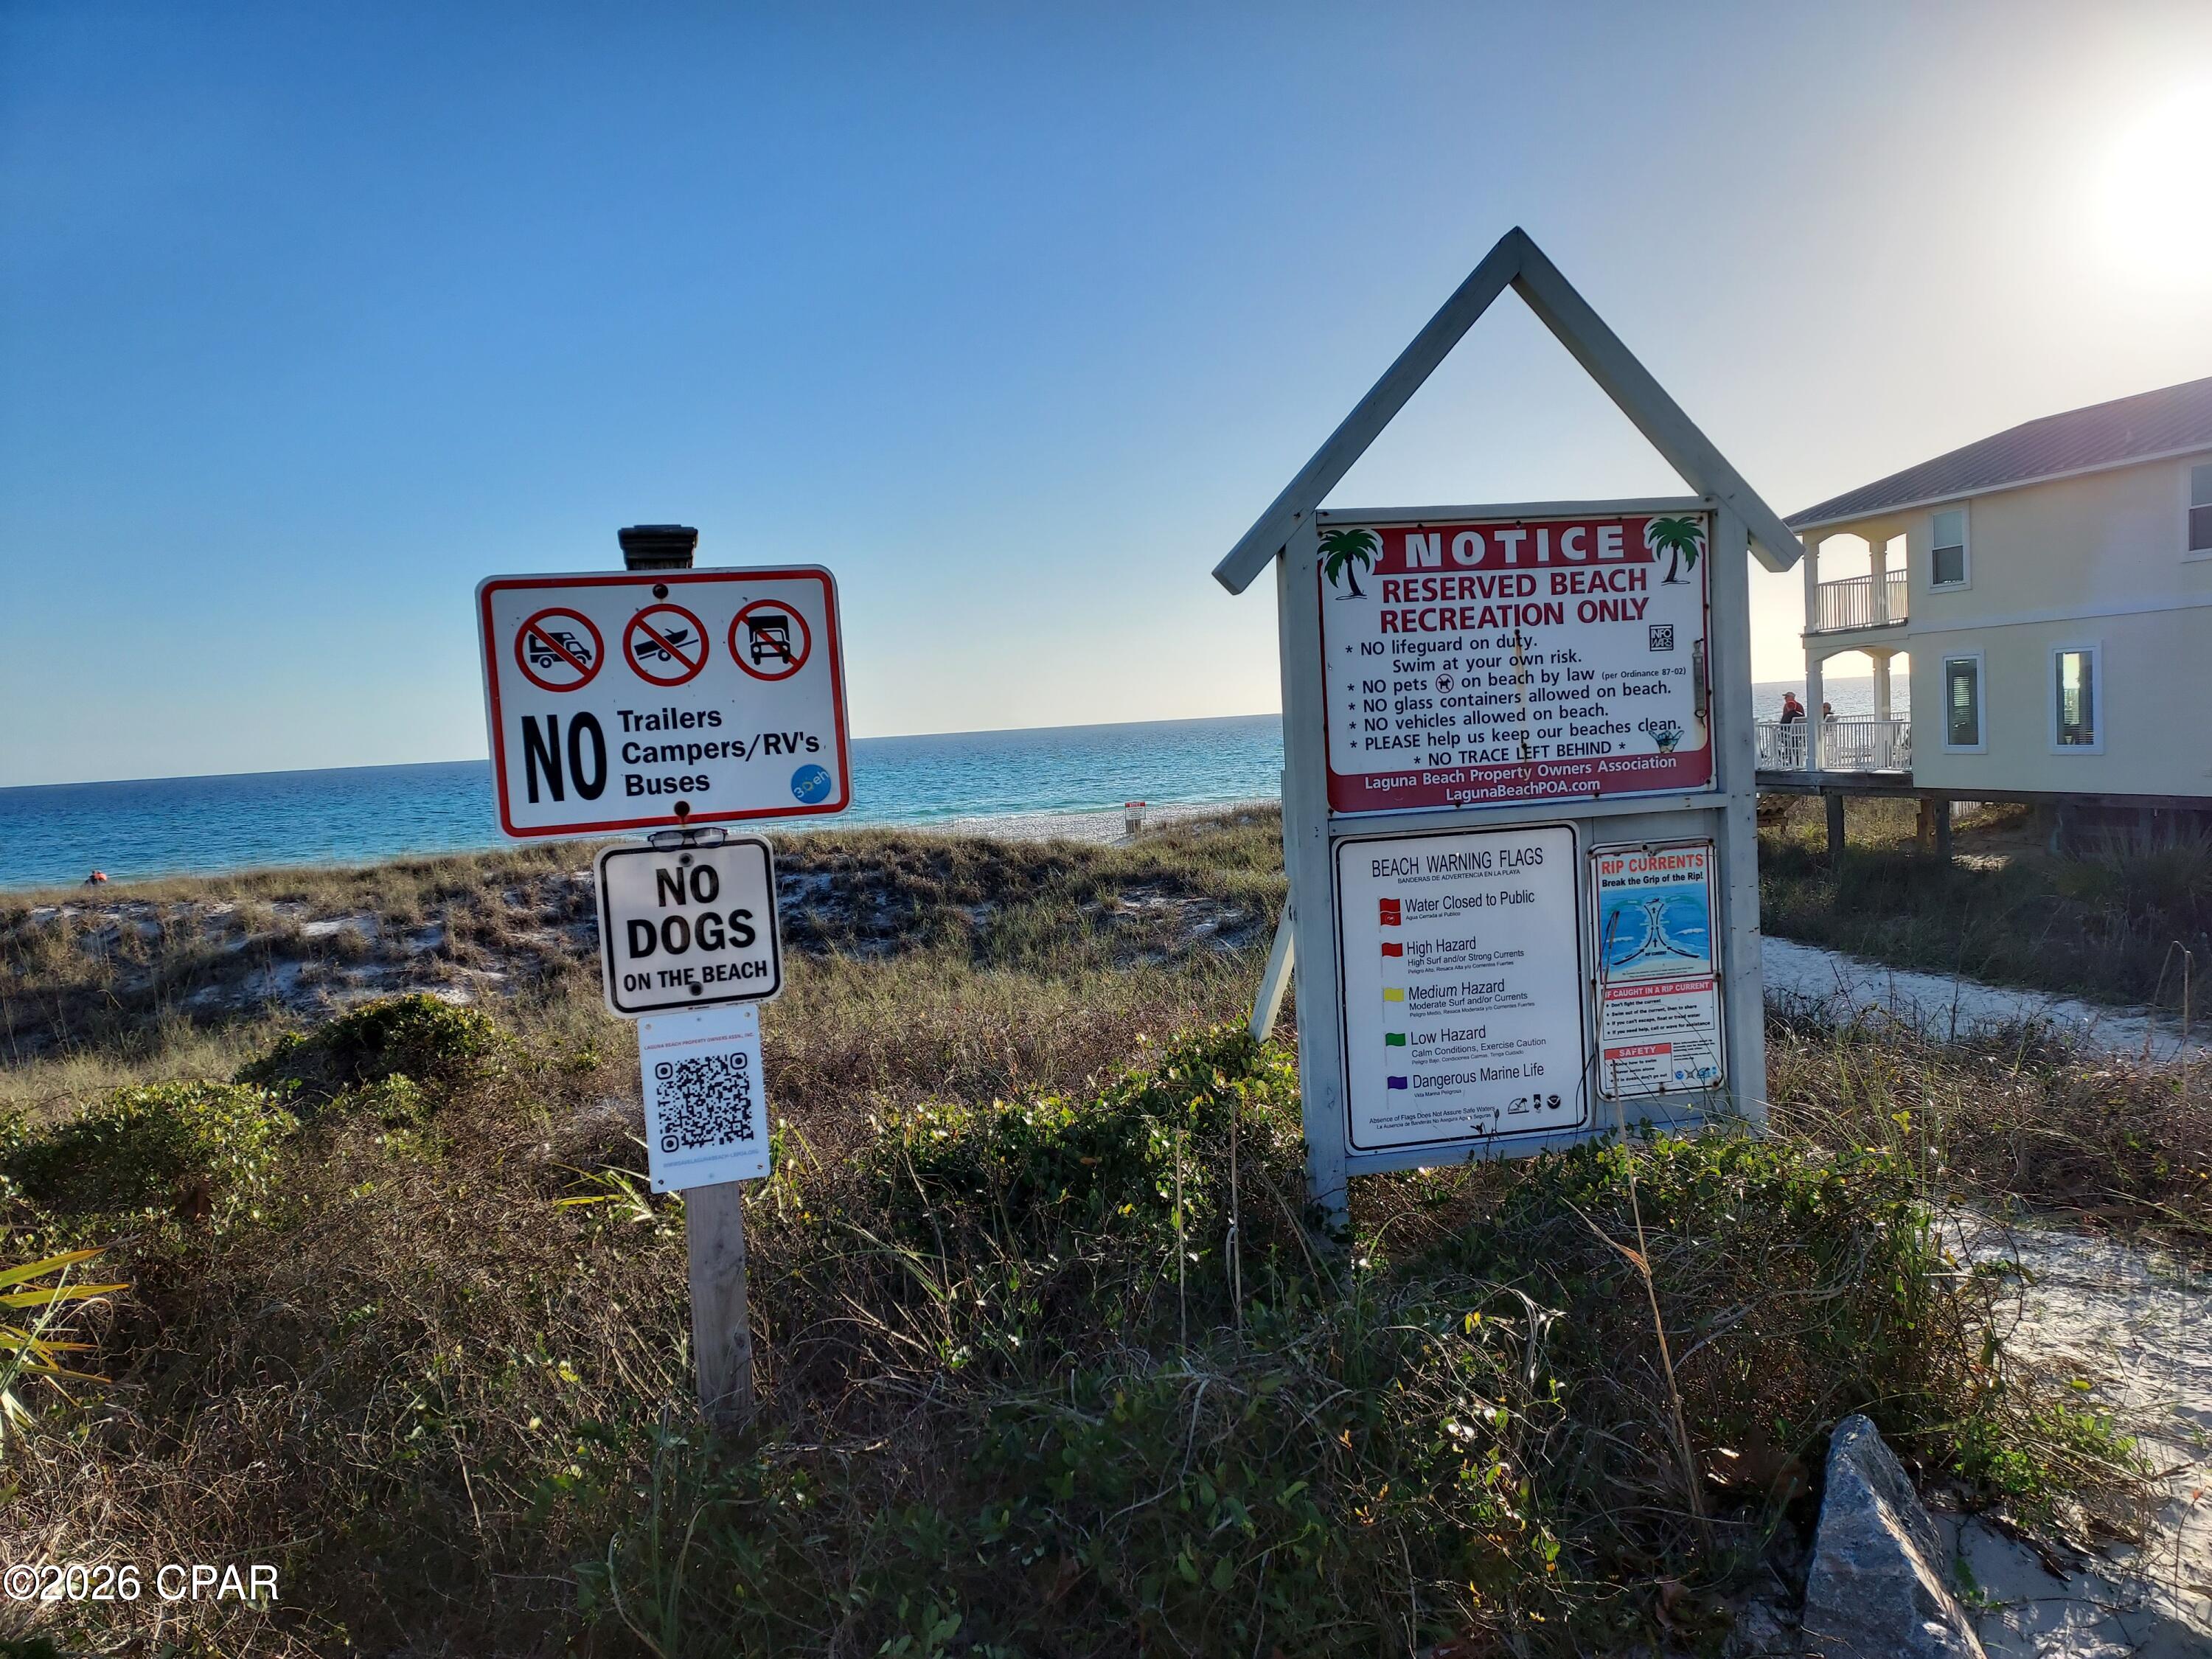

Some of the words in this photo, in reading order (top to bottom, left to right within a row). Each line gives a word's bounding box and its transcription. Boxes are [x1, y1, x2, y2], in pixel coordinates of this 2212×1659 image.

[1405, 525, 1624, 568] NOTICE
[1382, 574, 1537, 603] RESERVED
[1551, 568, 1646, 596] BEACH
[1380, 602, 1564, 633] RECREATION
[1577, 597, 1649, 623] ONLY
[1361, 641, 1385, 655] NO
[1392, 636, 1462, 657] lifeguard
[1470, 639, 1489, 650] on
[1496, 633, 1537, 653] duty.
[1651, 628, 1672, 638] INFO
[1393, 658, 1435, 673] Swim
[1443, 657, 1458, 670] at
[1466, 657, 1502, 672] your
[1509, 655, 1543, 666] own
[1551, 649, 1582, 664] risk.
[1363, 679, 1386, 694] NO
[1394, 678, 1427, 696] pets
[1461, 677, 1481, 688] on
[1488, 669, 1534, 686] beach
[1541, 669, 1559, 686] by
[1567, 667, 1595, 681] law
[1601, 671, 1618, 681] (per
[1621, 669, 1659, 678] Ordinance
[1662, 667, 1686, 675] 87-02)
[1363, 698, 1387, 713] NO
[1394, 696, 1433, 714] glass
[1440, 691, 1521, 708] containers
[1528, 684, 1590, 703] allowed
[1597, 687, 1615, 698] on
[1623, 680, 1671, 696] beach.
[617, 707, 722, 732] Trailers
[1364, 717, 1388, 731] NO
[1395, 712, 1455, 729] vehicles
[1463, 707, 1526, 726] allowed
[1533, 709, 1552, 720] on
[1559, 703, 1608, 719] beach.
[1366, 734, 1421, 751] PLEASE
[1427, 731, 1461, 748] help
[1468, 733, 1484, 743] us
[1492, 728, 1530, 746] keep
[1537, 727, 1562, 739] our
[1570, 720, 1631, 737] beaches
[1638, 717, 1681, 732] clean.
[521, 712, 607, 804] NO
[622, 731, 820, 765] Campers/RV's
[1428, 752, 1452, 766] NO
[1458, 748, 1509, 764] TRACE
[1516, 744, 1550, 762] LEFT
[1557, 741, 1612, 757] BEHIND
[625, 774, 710, 796] Buses
[1365, 776, 1416, 791] Laguna
[1423, 769, 1464, 785] Beach
[1470, 767, 1532, 783] Property
[1537, 764, 1592, 776] Owners
[1597, 756, 1677, 773] Association
[1446, 780, 1600, 803] LagunaBeachPOA.com
[1372, 857, 1419, 877] BEACH
[1426, 851, 1492, 873] WARNING
[1500, 847, 1543, 868] FLAGS
[1601, 860, 1624, 874] RIP
[1629, 853, 1703, 872] CURRENTS
[656, 864, 720, 907] NO
[1397, 876, 1430, 884] BANDERAS
[1441, 872, 1484, 880] ADVERTENCIA
[1602, 878, 1626, 888] Break
[1627, 877, 1641, 886] the
[1643, 875, 1660, 885] Grip
[1662, 874, 1670, 882] of
[1672, 873, 1686, 881] the
[1688, 871, 1703, 881] Rip!
[1405, 898, 1439, 913] Water
[1443, 893, 1482, 910] Closed
[1486, 893, 1497, 906] to
[1500, 889, 1534, 905] Public
[627, 908, 756, 959] DOGS
[1407, 940, 1433, 958] High
[1436, 936, 1476, 953] Hazard
[1408, 958, 1425, 968] High
[1426, 956, 1441, 965] Surf
[1443, 954, 1467, 964] and/or
[1468, 953, 1492, 961] Strong
[1494, 950, 1524, 959] Currents
[624, 973, 651, 992] ON
[657, 968, 695, 989] THE
[703, 960, 768, 984] BEACH
[1408, 984, 1457, 1001] Medium
[1461, 978, 1505, 995] Hazard
[1613, 988, 1644, 997] CAUGHT
[1661, 984, 1674, 992] RIP
[1675, 981, 1709, 990] CURRENT
[1409, 1001, 1447, 1011] Moderate
[1449, 998, 1465, 1006] Surf
[1467, 995, 1492, 1005] and/or
[1495, 992, 1528, 1002] Currents
[1411, 1032, 1436, 1046] Low
[1441, 1025, 1486, 1042] Hazard
[1411, 1048, 1433, 1058] Calm
[1434, 1046, 1478, 1055] Conditions,
[1481, 1041, 1514, 1051] Exercise
[1516, 1038, 1546, 1047] Caution
[1619, 1046, 1656, 1057] SAFETY
[1413, 1072, 1476, 1090] Dangerous
[1480, 1065, 1520, 1082] Marine
[1523, 1062, 1544, 1077] Life
